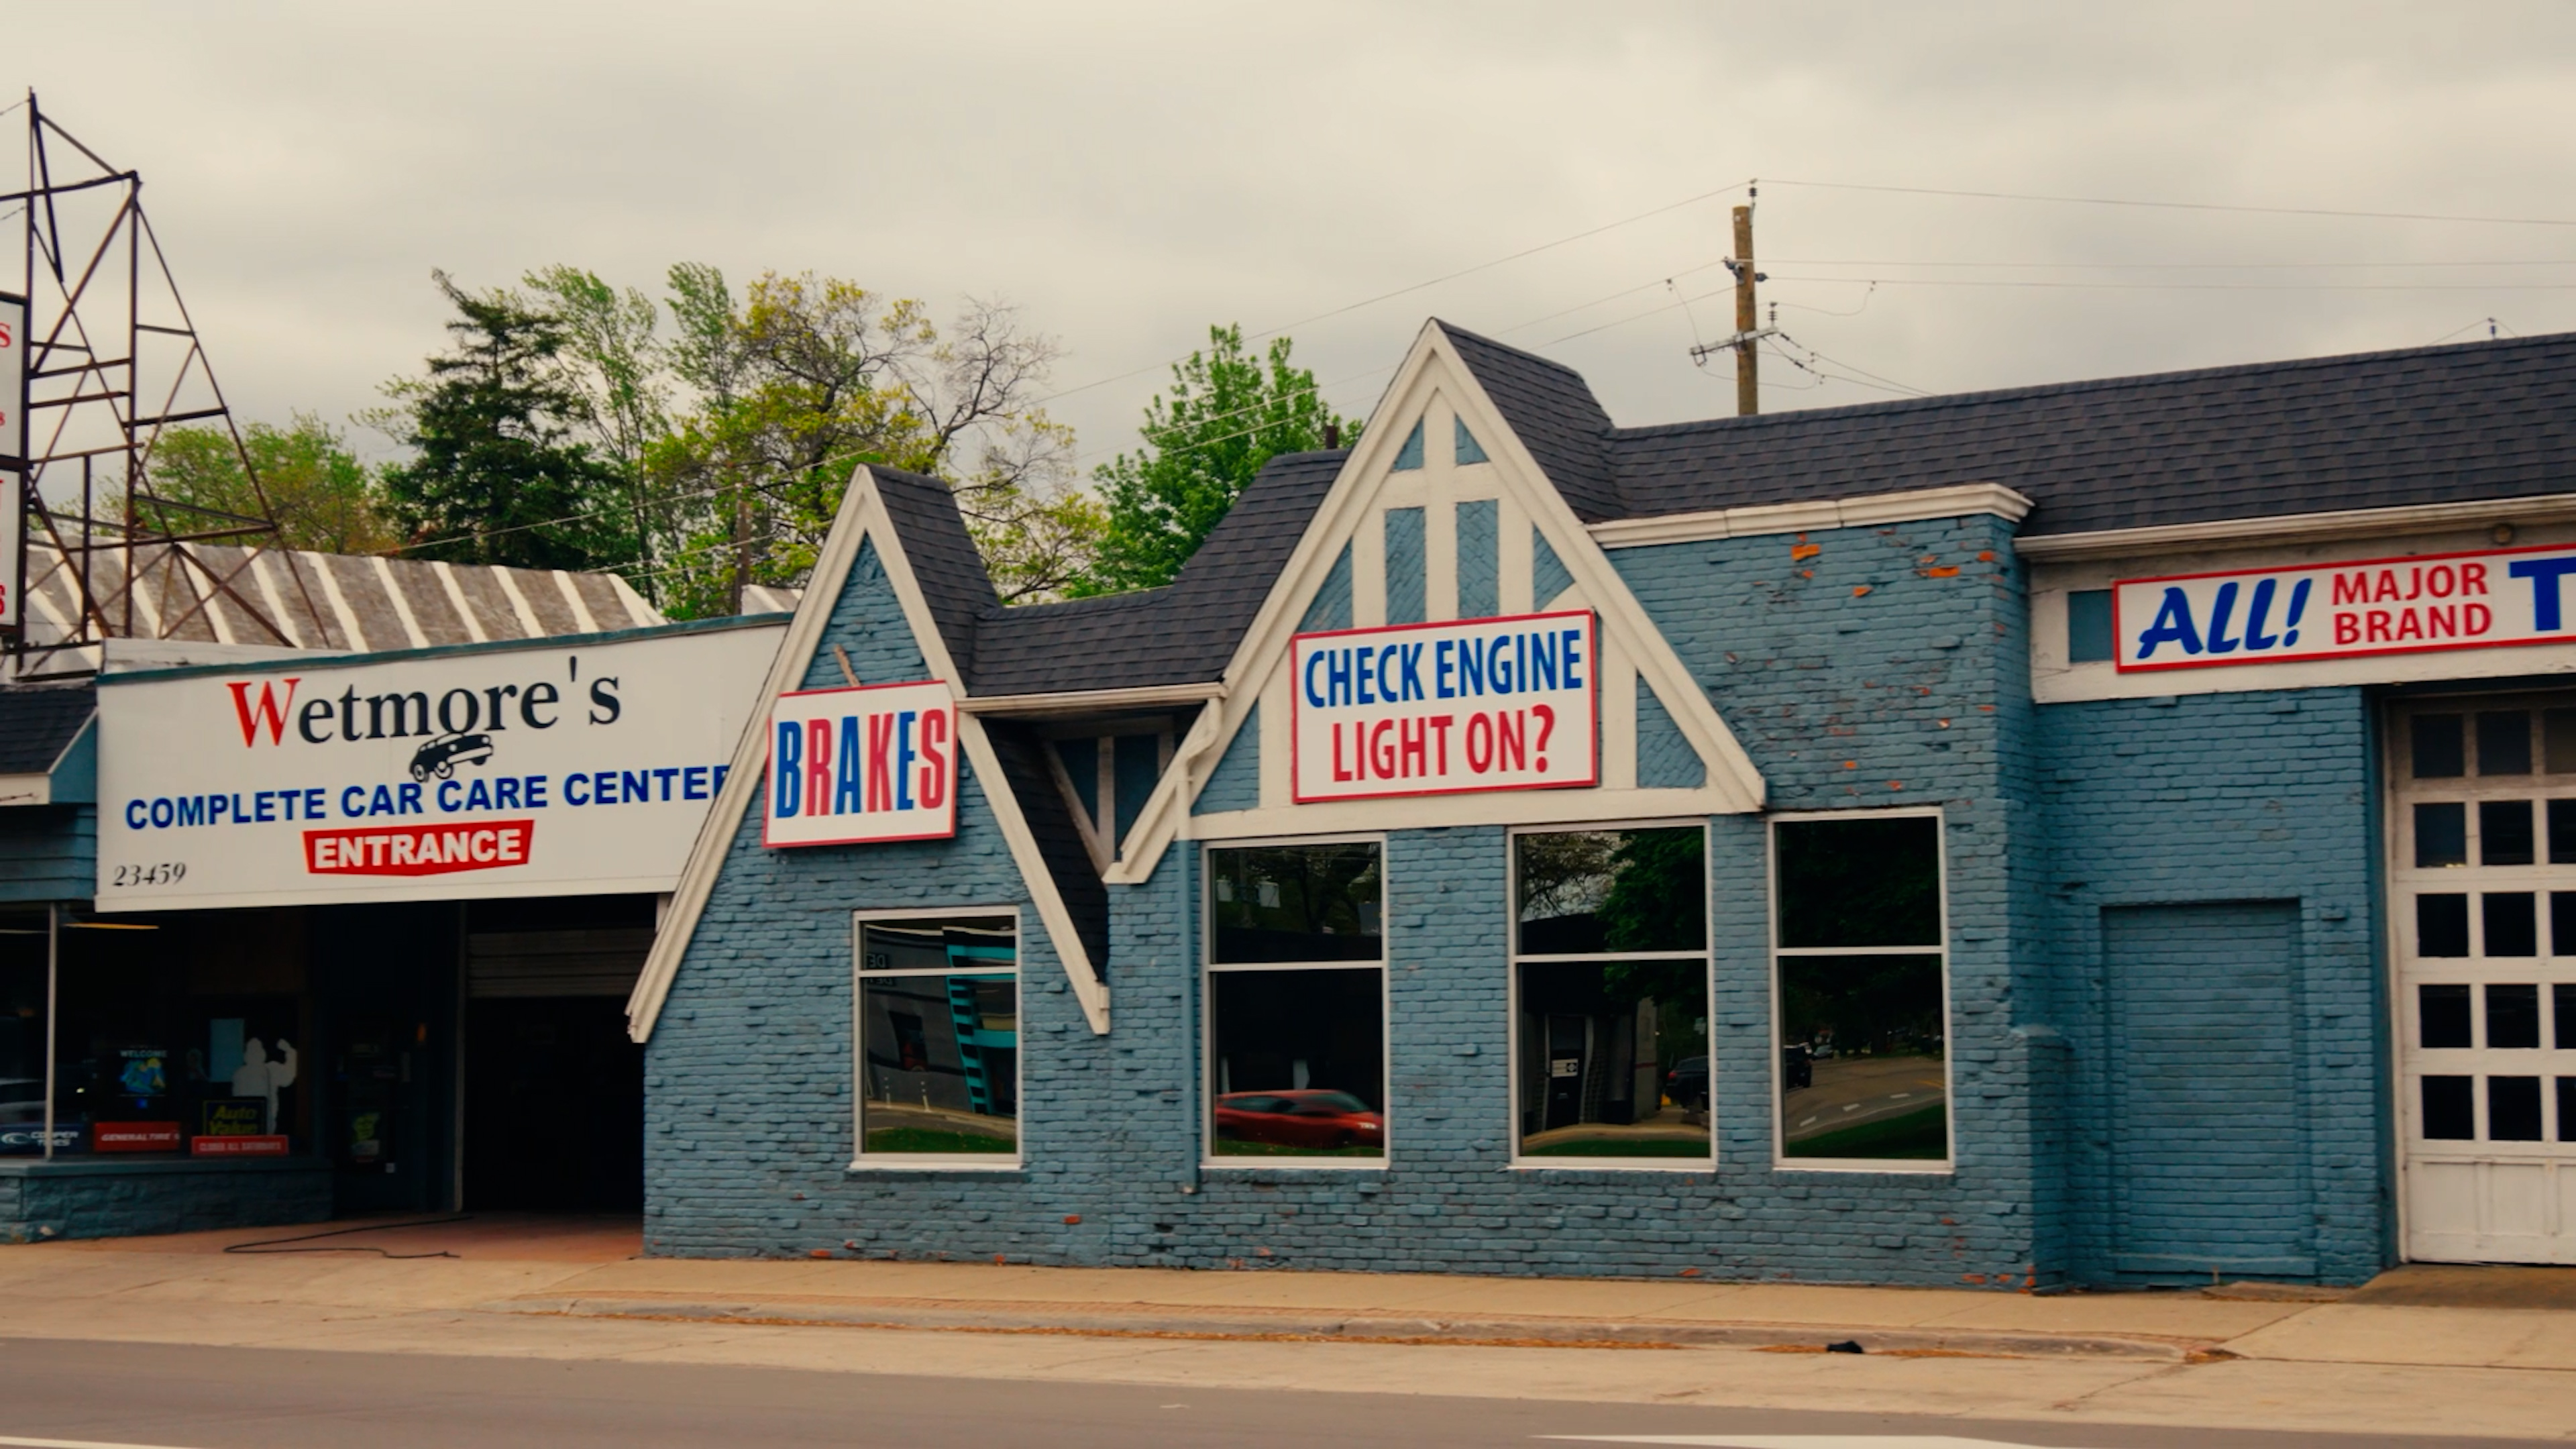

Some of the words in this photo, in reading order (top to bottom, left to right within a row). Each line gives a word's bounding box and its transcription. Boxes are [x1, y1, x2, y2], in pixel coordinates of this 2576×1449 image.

[2331, 561, 2489, 606] MAJOR
[2136, 577, 2313, 659] ALL!
[2333, 602, 2493, 646] BRAND
[1304, 641, 1426, 709] CHECK
[1435, 629, 1583, 700] ENGINE
[226, 655, 621, 748] Wetmore's
[775, 708, 947, 819] BRAKES
[1332, 714, 1454, 783] LIGHT
[1465, 703, 1556, 775] ON?
[125, 787, 327, 830] COMPLETE
[340, 782, 424, 818] CAR
[436, 774, 549, 813] CARE
[314, 828, 521, 869] ENTRANCE
[113, 863, 187, 887] 23459
[209, 1120, 258, 1135] Value
[212, 1104, 258, 1120] Auto
